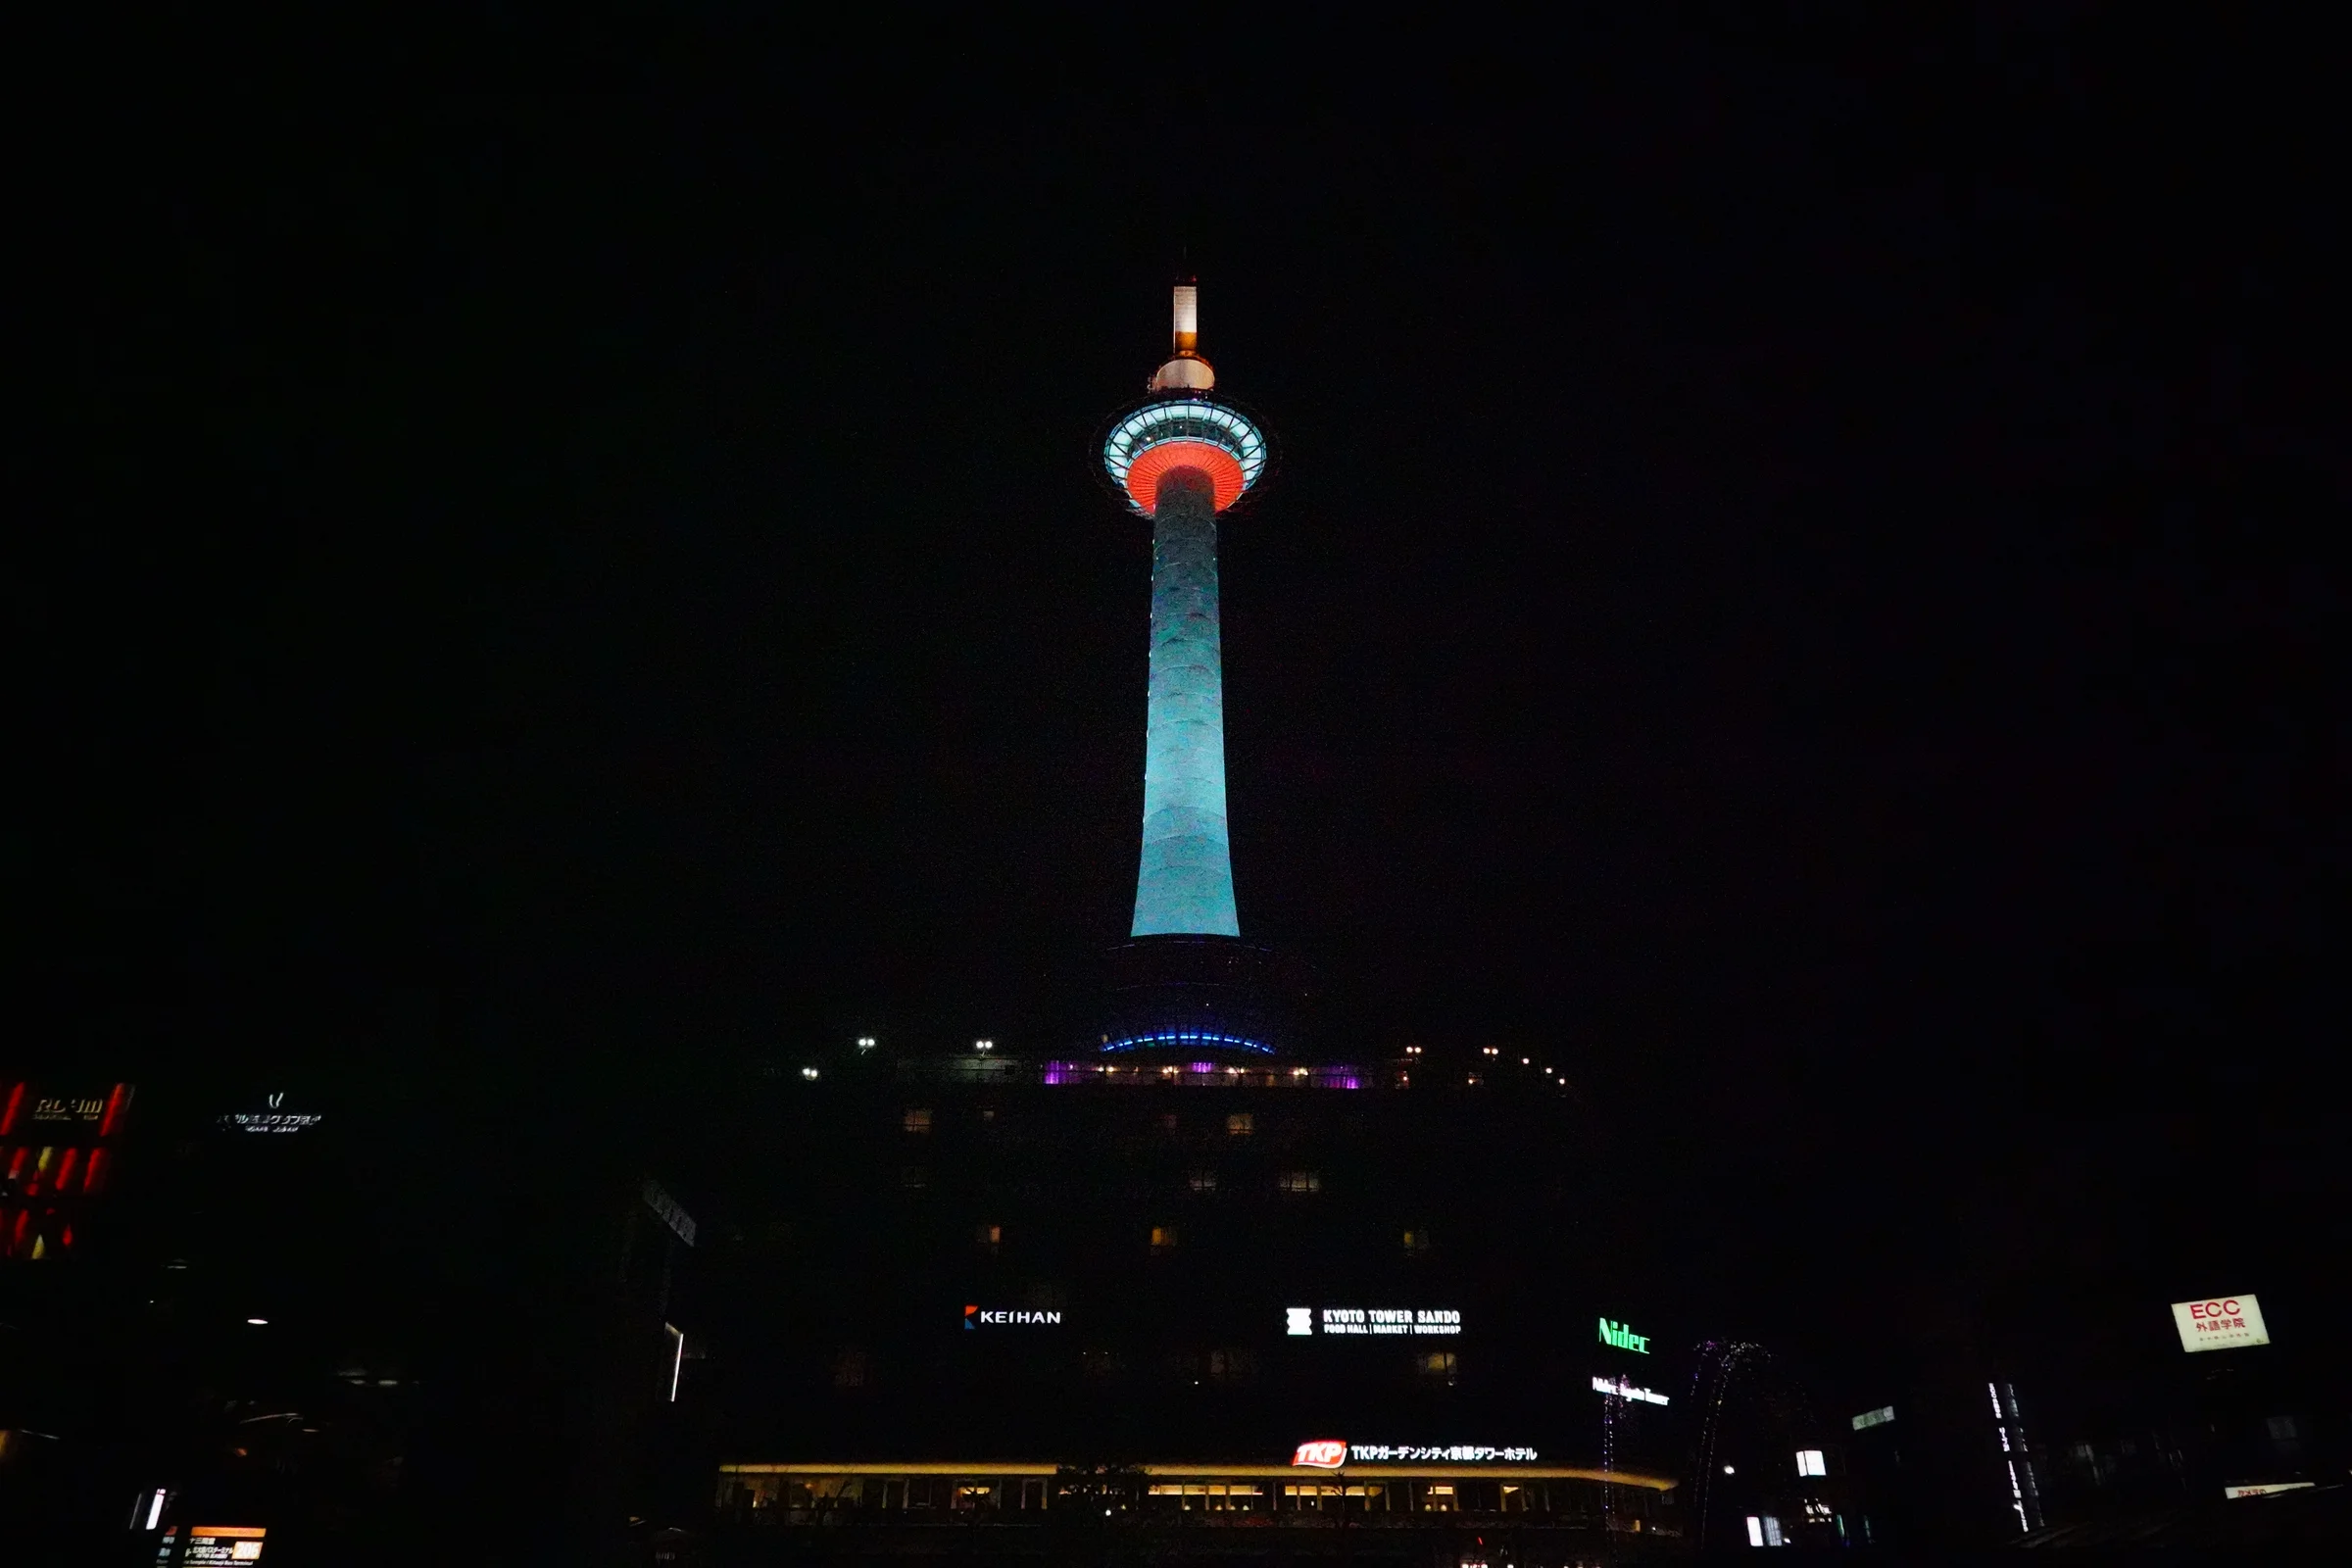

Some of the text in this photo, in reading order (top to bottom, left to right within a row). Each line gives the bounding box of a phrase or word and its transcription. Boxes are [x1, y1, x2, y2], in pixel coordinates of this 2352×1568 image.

[980, 1310, 1061, 1324] KEIHAN
[1323, 1309, 1461, 1324] KYOTO TOWER SANDO
[2189, 1299, 2241, 1320] ECC
[1324, 1324, 1461, 1335] FOOD HALL MARKET WORKSHOP
[2195, 1317, 2246, 1332] 外語学院
[1598, 1317, 1650, 1354] Nidec
[1297, 1444, 1344, 1463] TKP
[1350, 1446, 1538, 1460] TKPガーデンシティ京都タワーホテル
